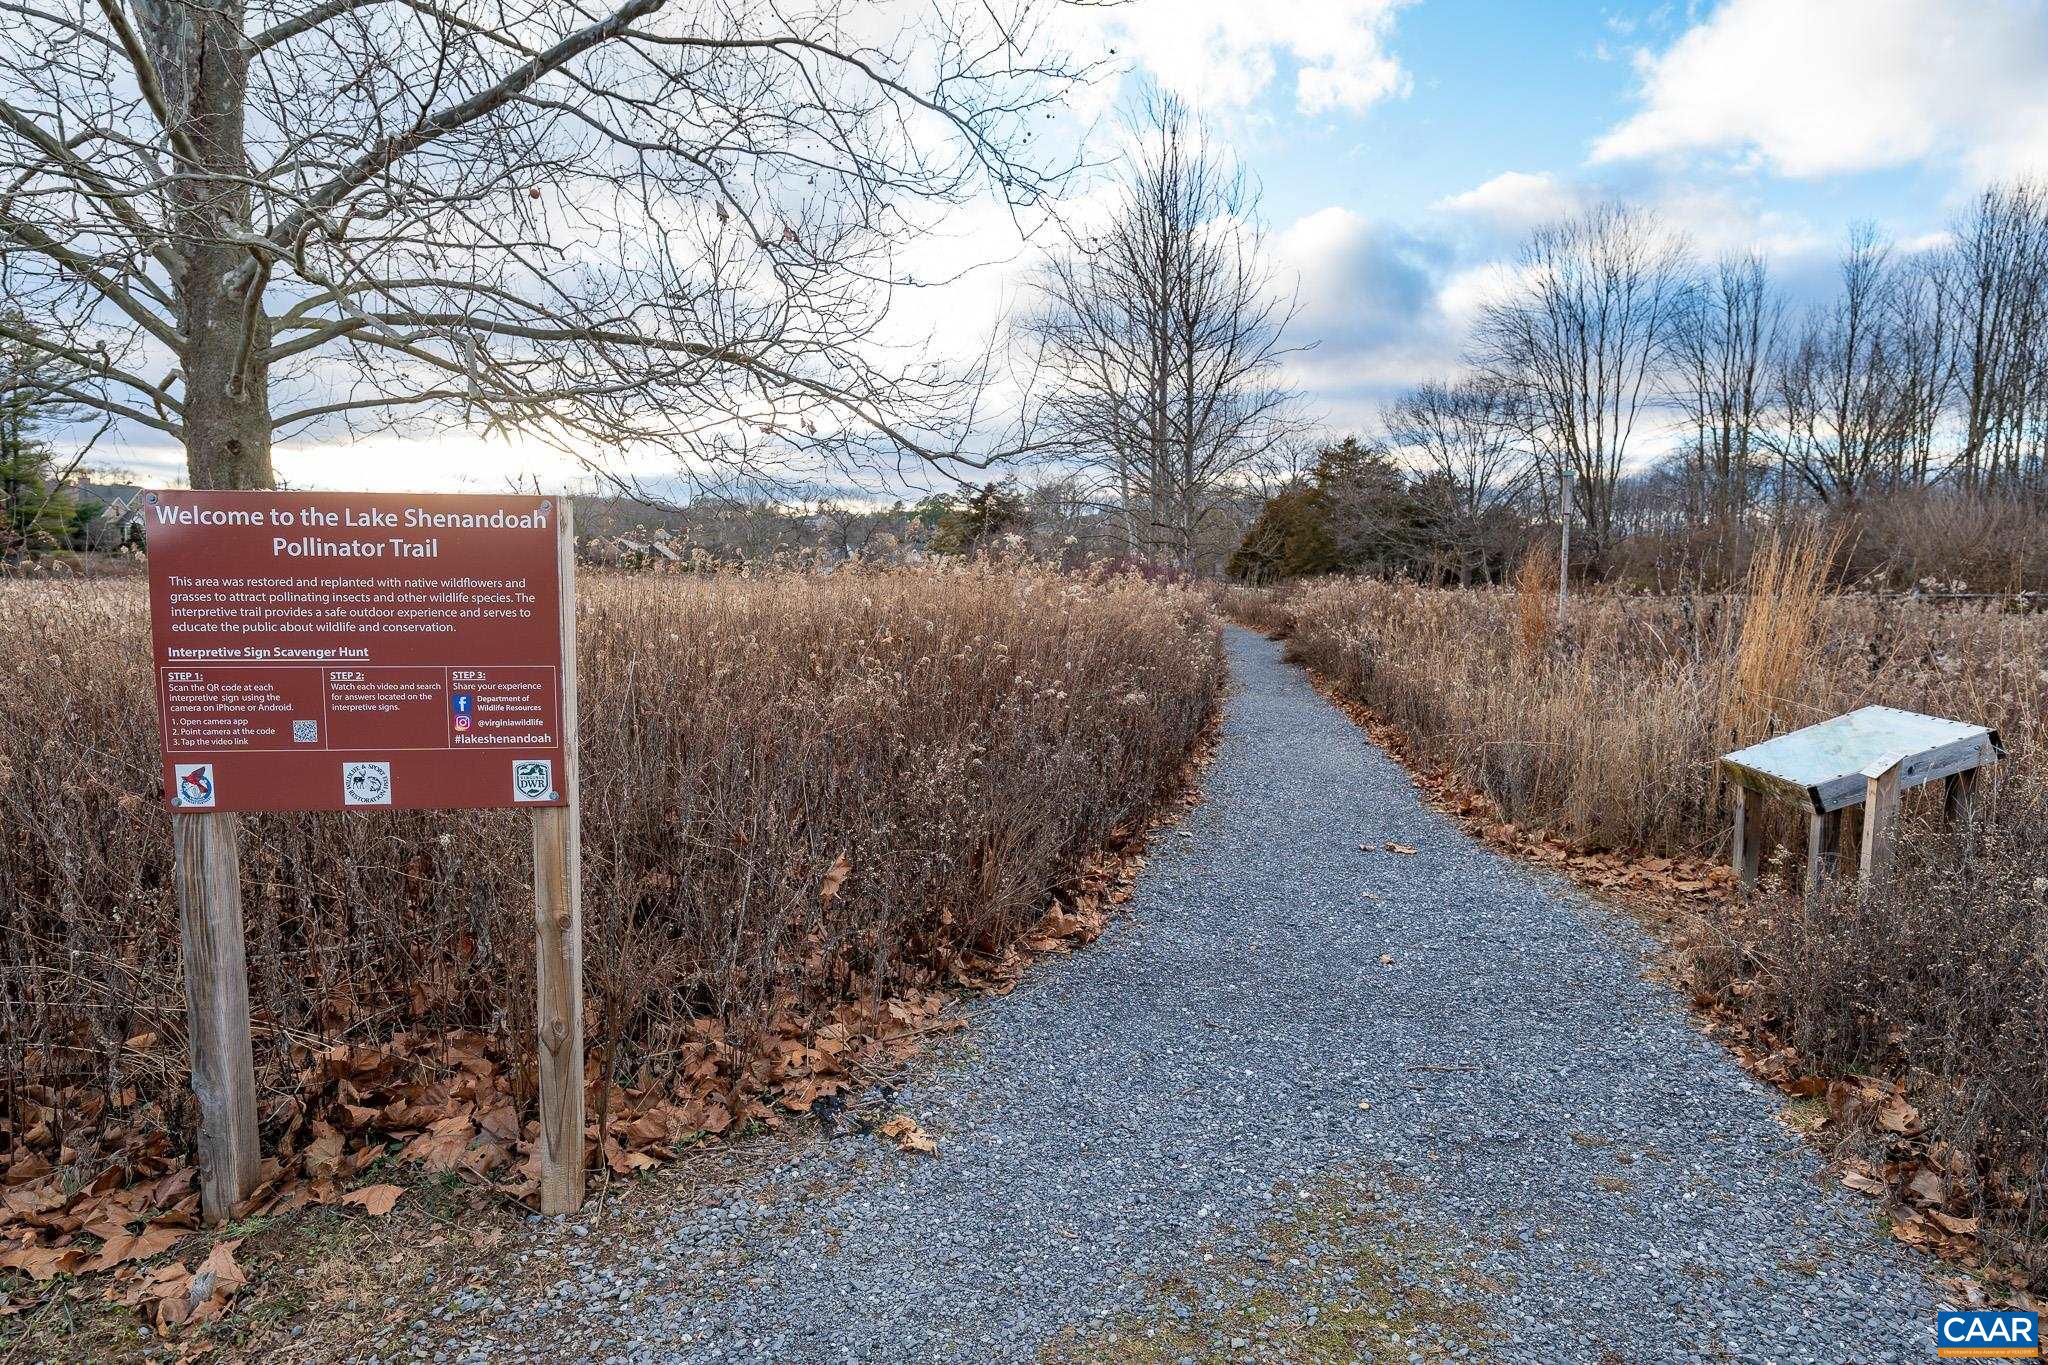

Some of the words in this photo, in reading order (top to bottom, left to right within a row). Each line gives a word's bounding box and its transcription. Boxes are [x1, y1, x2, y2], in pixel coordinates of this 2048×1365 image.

[155, 506, 264, 525] Welcome
[270, 508, 294, 526] to
[300, 507, 338, 526] the
[345, 508, 398, 527] Lake
[404, 508, 547, 529] Shenandoah
[273, 537, 385, 557] Pollinator
[389, 538, 438, 558] Trail
[169, 576, 192, 587] This
[195, 579, 219, 587] area
[221, 579, 244, 587] was
[247, 577, 293, 587] restored
[296, 577, 317, 587] and
[321, 577, 373, 589] replanted
[377, 578, 401, 588] with
[404, 578, 438, 588] native
[441, 578, 502, 588] wildflowers
[505, 578, 526, 588] and
[170, 593, 212, 603] grasses
[215, 593, 226, 602] to
[229, 593, 266, 602] attract
[269, 592, 329, 604] pollinating
[333, 592, 370, 602] insects
[373, 593, 394, 602] and
[398, 593, 426, 603] other
[430, 592, 469, 602] wildlife
[472, 593, 514, 605] species.
[515, 593, 535, 603] The
[171, 607, 237, 618] interpretive
[240, 607, 262, 617] trail
[264, 607, 313, 618] provides
[316, 609, 321, 617] a
[325, 607, 347, 617] safe
[350, 608, 394, 617] outdoor
[398, 608, 457, 619] experience
[460, 608, 480, 617] and
[483, 609, 517, 618] serves
[520, 608, 531, 618] to
[172, 622, 217, 632] educate
[221, 622, 239, 632] the
[242, 622, 277, 634] public
[280, 622, 313, 632] about
[316, 622, 356, 632] wildlife
[359, 622, 379, 632] and
[382, 623, 456, 632] conservation.
[168, 647, 241, 659] Interpretive
[244, 647, 270, 659] Sign
[274, 647, 336, 659] Scavenger
[339, 647, 369, 656] Hunt
[168, 672, 192, 680] STEP
[195, 672, 203, 680] 1:
[330, 672, 353, 680] STEP
[356, 672, 364, 680] 2:
[169, 684, 188, 692] Scan
[207, 684, 219, 692] QR
[498, 683, 541, 691] experience
[169, 694, 218, 702] interpretive
[222, 694, 239, 702] sign
[242, 694, 264, 702] using
[332, 704, 376, 712] interpretive
[378, 704, 399, 712] signs.
[180, 718, 201, 726] Open
[478, 719, 543, 727] @virginiawildlife
[454, 734, 551, 744] #lakeshenandoah
[368, 764, 385, 775] SPORT
[521, 780, 545, 788] DWR
[349, 790, 386, 803] RESTORATION
